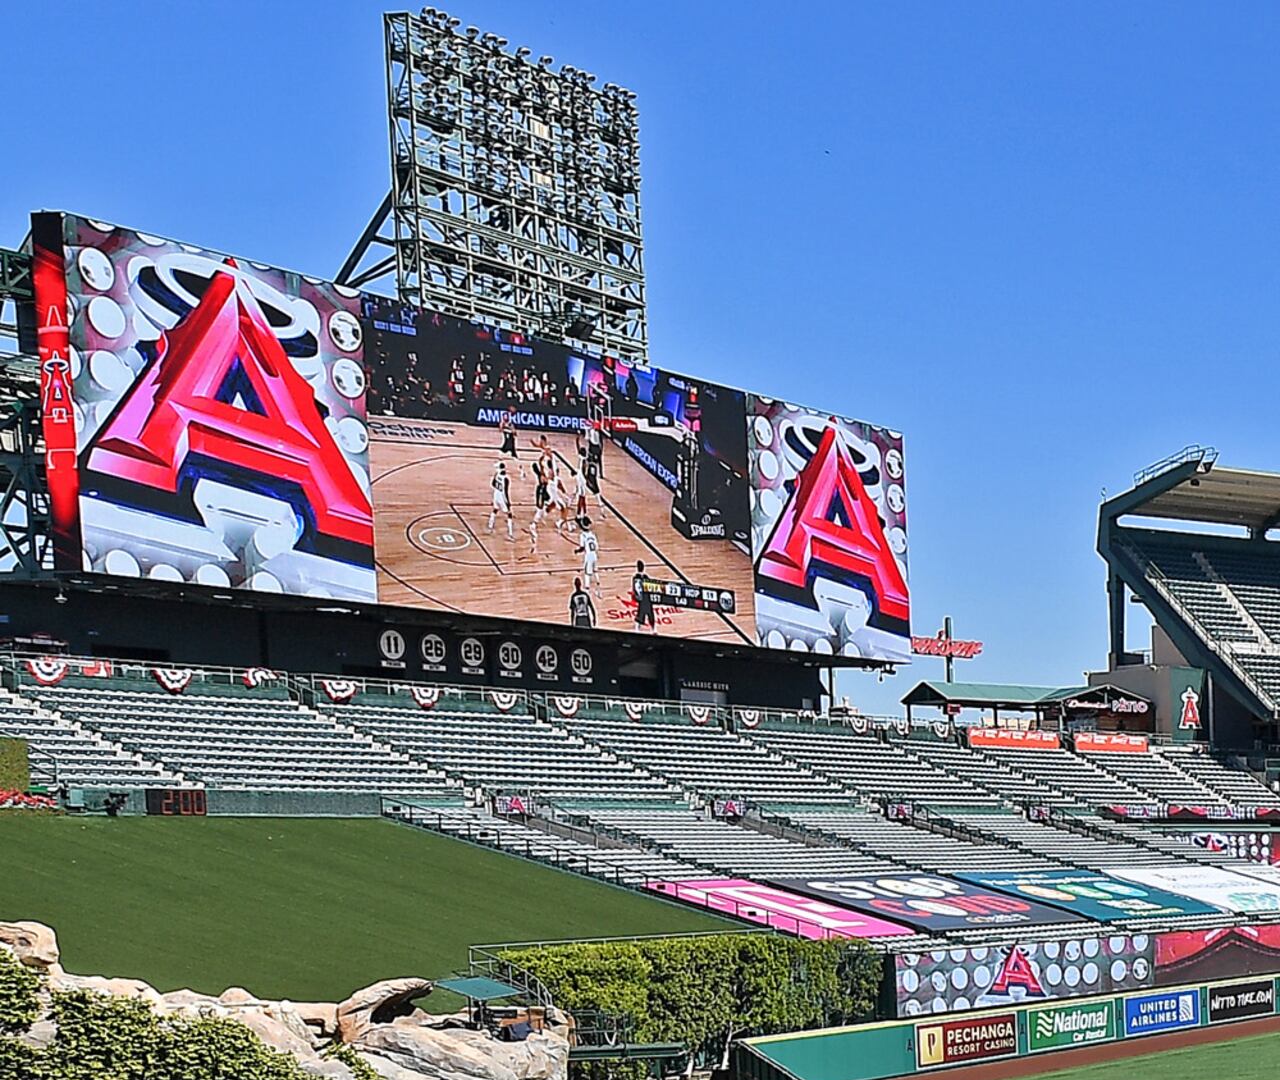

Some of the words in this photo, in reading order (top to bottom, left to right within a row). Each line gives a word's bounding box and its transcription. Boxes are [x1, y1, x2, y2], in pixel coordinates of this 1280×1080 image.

[386, 635, 400, 652] 11
[424, 639, 444, 658] 26
[464, 643, 482, 661] 29
[501, 646, 520, 663] 30
[537, 650, 557, 667] 42
[573, 654, 591, 670] 50
[1112, 698, 1149, 714] PATIO
[162, 791, 206, 815] 2:00
[1139, 999, 1177, 1013] UNITED
[1210, 994, 1235, 1011] NITTO
[1053, 1005, 1109, 1034] National
[1131, 1011, 1177, 1027] AIRLINES
[946, 1022, 1014, 1045] PECHANGA
[1073, 1031, 1085, 1042] Car
[1085, 1028, 1107, 1041] Rental
[947, 1041, 980, 1056] RESORT
[983, 1037, 1015, 1051] CASINO
